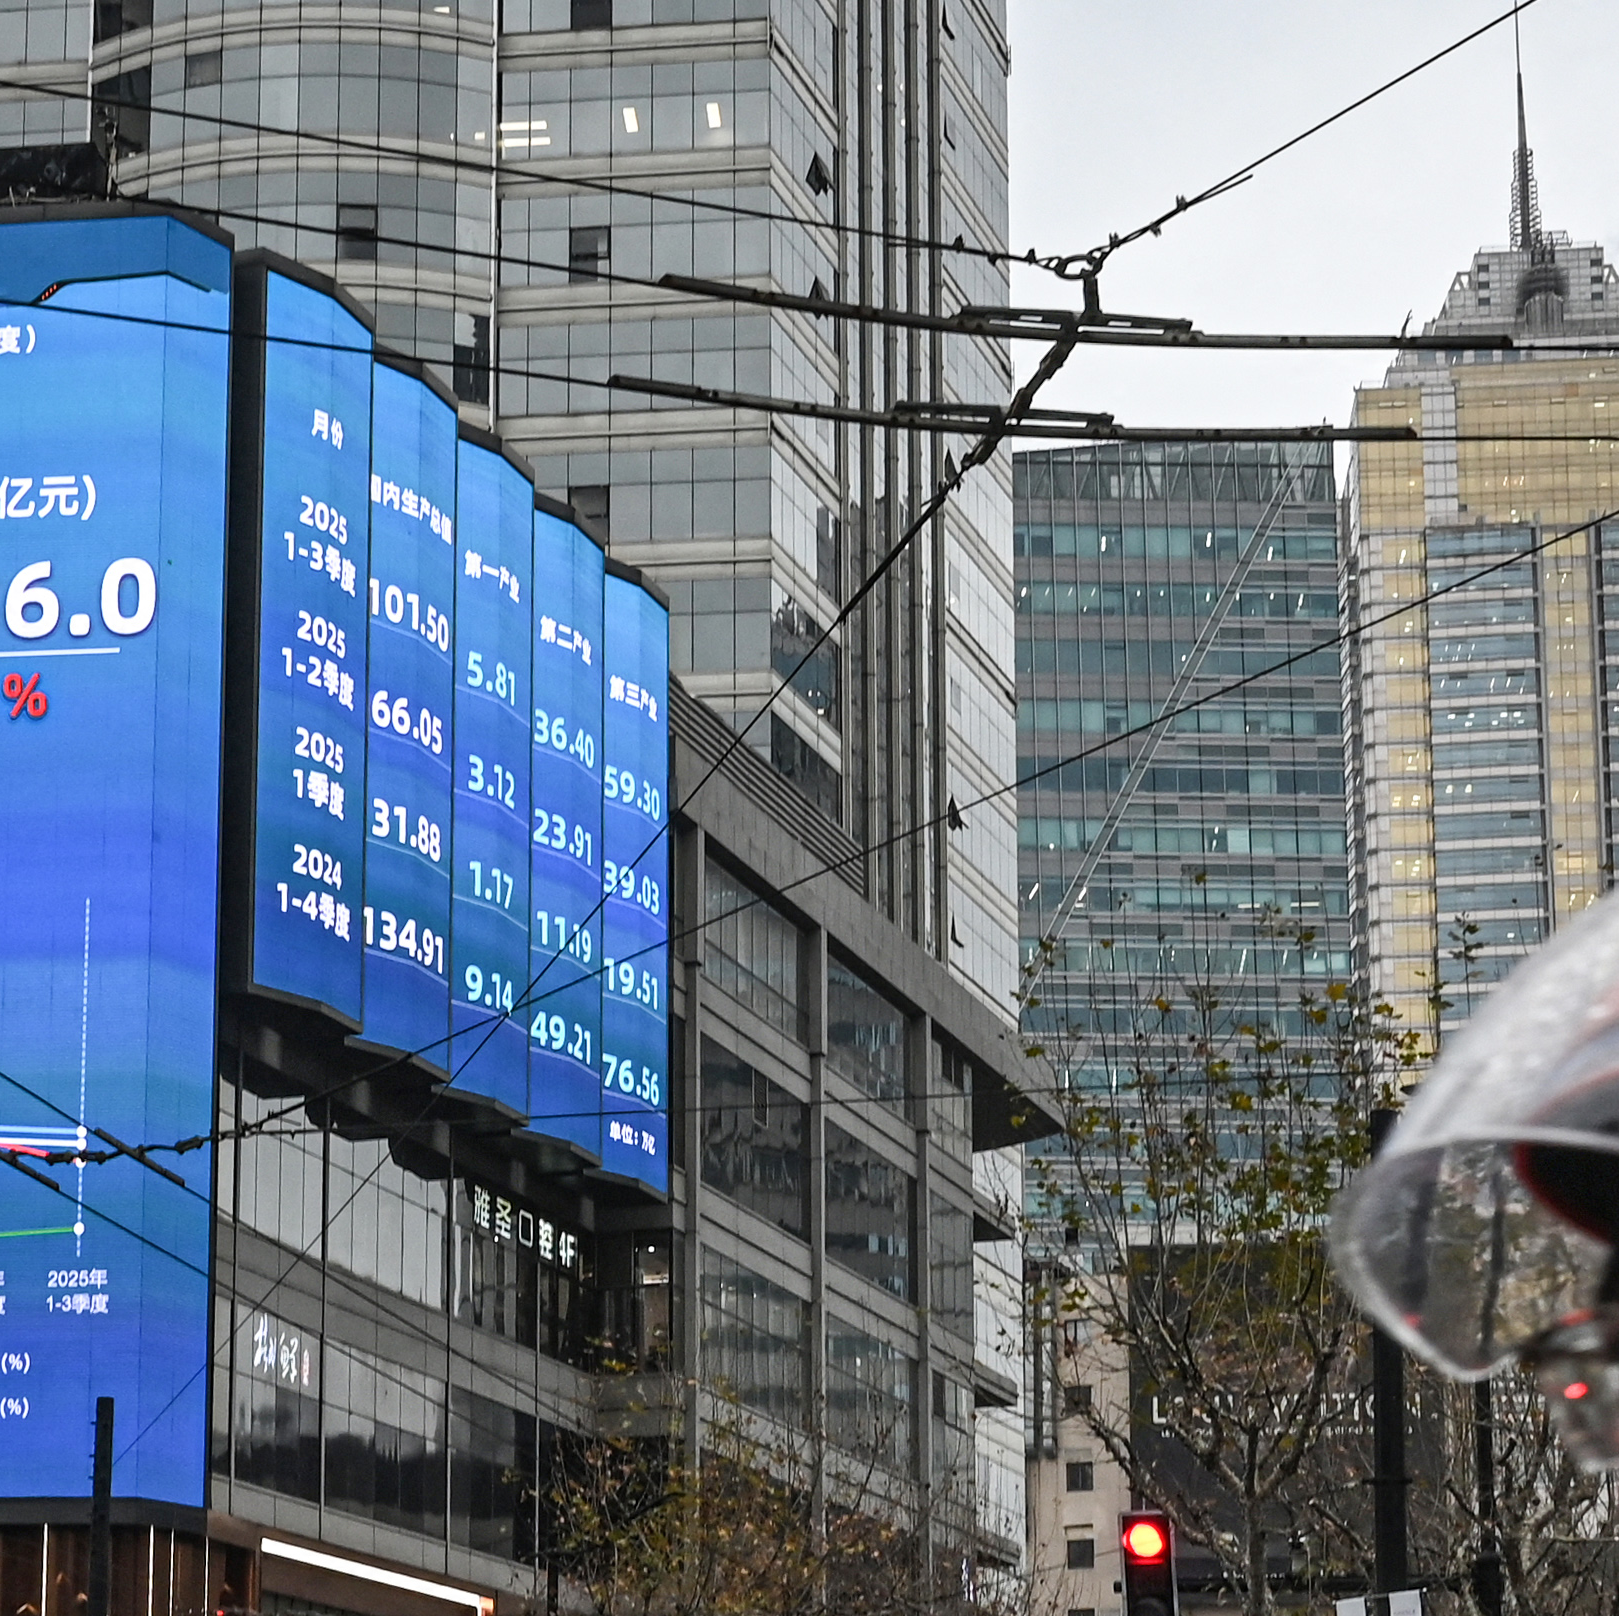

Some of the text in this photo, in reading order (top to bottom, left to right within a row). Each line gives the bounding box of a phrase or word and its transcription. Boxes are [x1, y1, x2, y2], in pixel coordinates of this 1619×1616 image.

[312, 408, 343, 449] 月份
[299, 495, 348, 545] 2025
[284, 531, 356, 598] 1-3季度
[464, 549, 520, 604] 第一产业
[297, 610, 346, 658] 2025
[370, 578, 449, 652] 101.50
[540, 615, 592, 666] 第二产业
[2, 673, 47, 719] %
[281, 648, 354, 711] 1-2季度
[467, 650, 515, 706] 5.81
[609, 674, 658, 722] 第三产业
[294, 726, 343, 773] 2025
[371, 690, 443, 755] 66.05
[534, 708, 594, 769] 36.40
[293, 769, 344, 821] 1季度
[468, 753, 515, 809] 3.12
[604, 764, 660, 821] 59.30
[371, 798, 441, 863] 31.88
[533, 808, 593, 866] 23.91
[292, 844, 342, 890] 2024
[469, 860, 514, 910] 1.17
[603, 860, 660, 915] 39.03
[277, 882, 351, 942] 1-4季度
[537, 910, 592, 964] 11.19
[363, 906, 444, 974] 134.91
[465, 964, 514, 1012] 9.14
[604, 958, 659, 1011] 19.51
[531, 1010, 591, 1065] 49.21
[603, 1053, 660, 1106] 76.56
[46, 1292, 109, 1315] 1-3季度
[47, 1268, 108, 1289] 2025年
